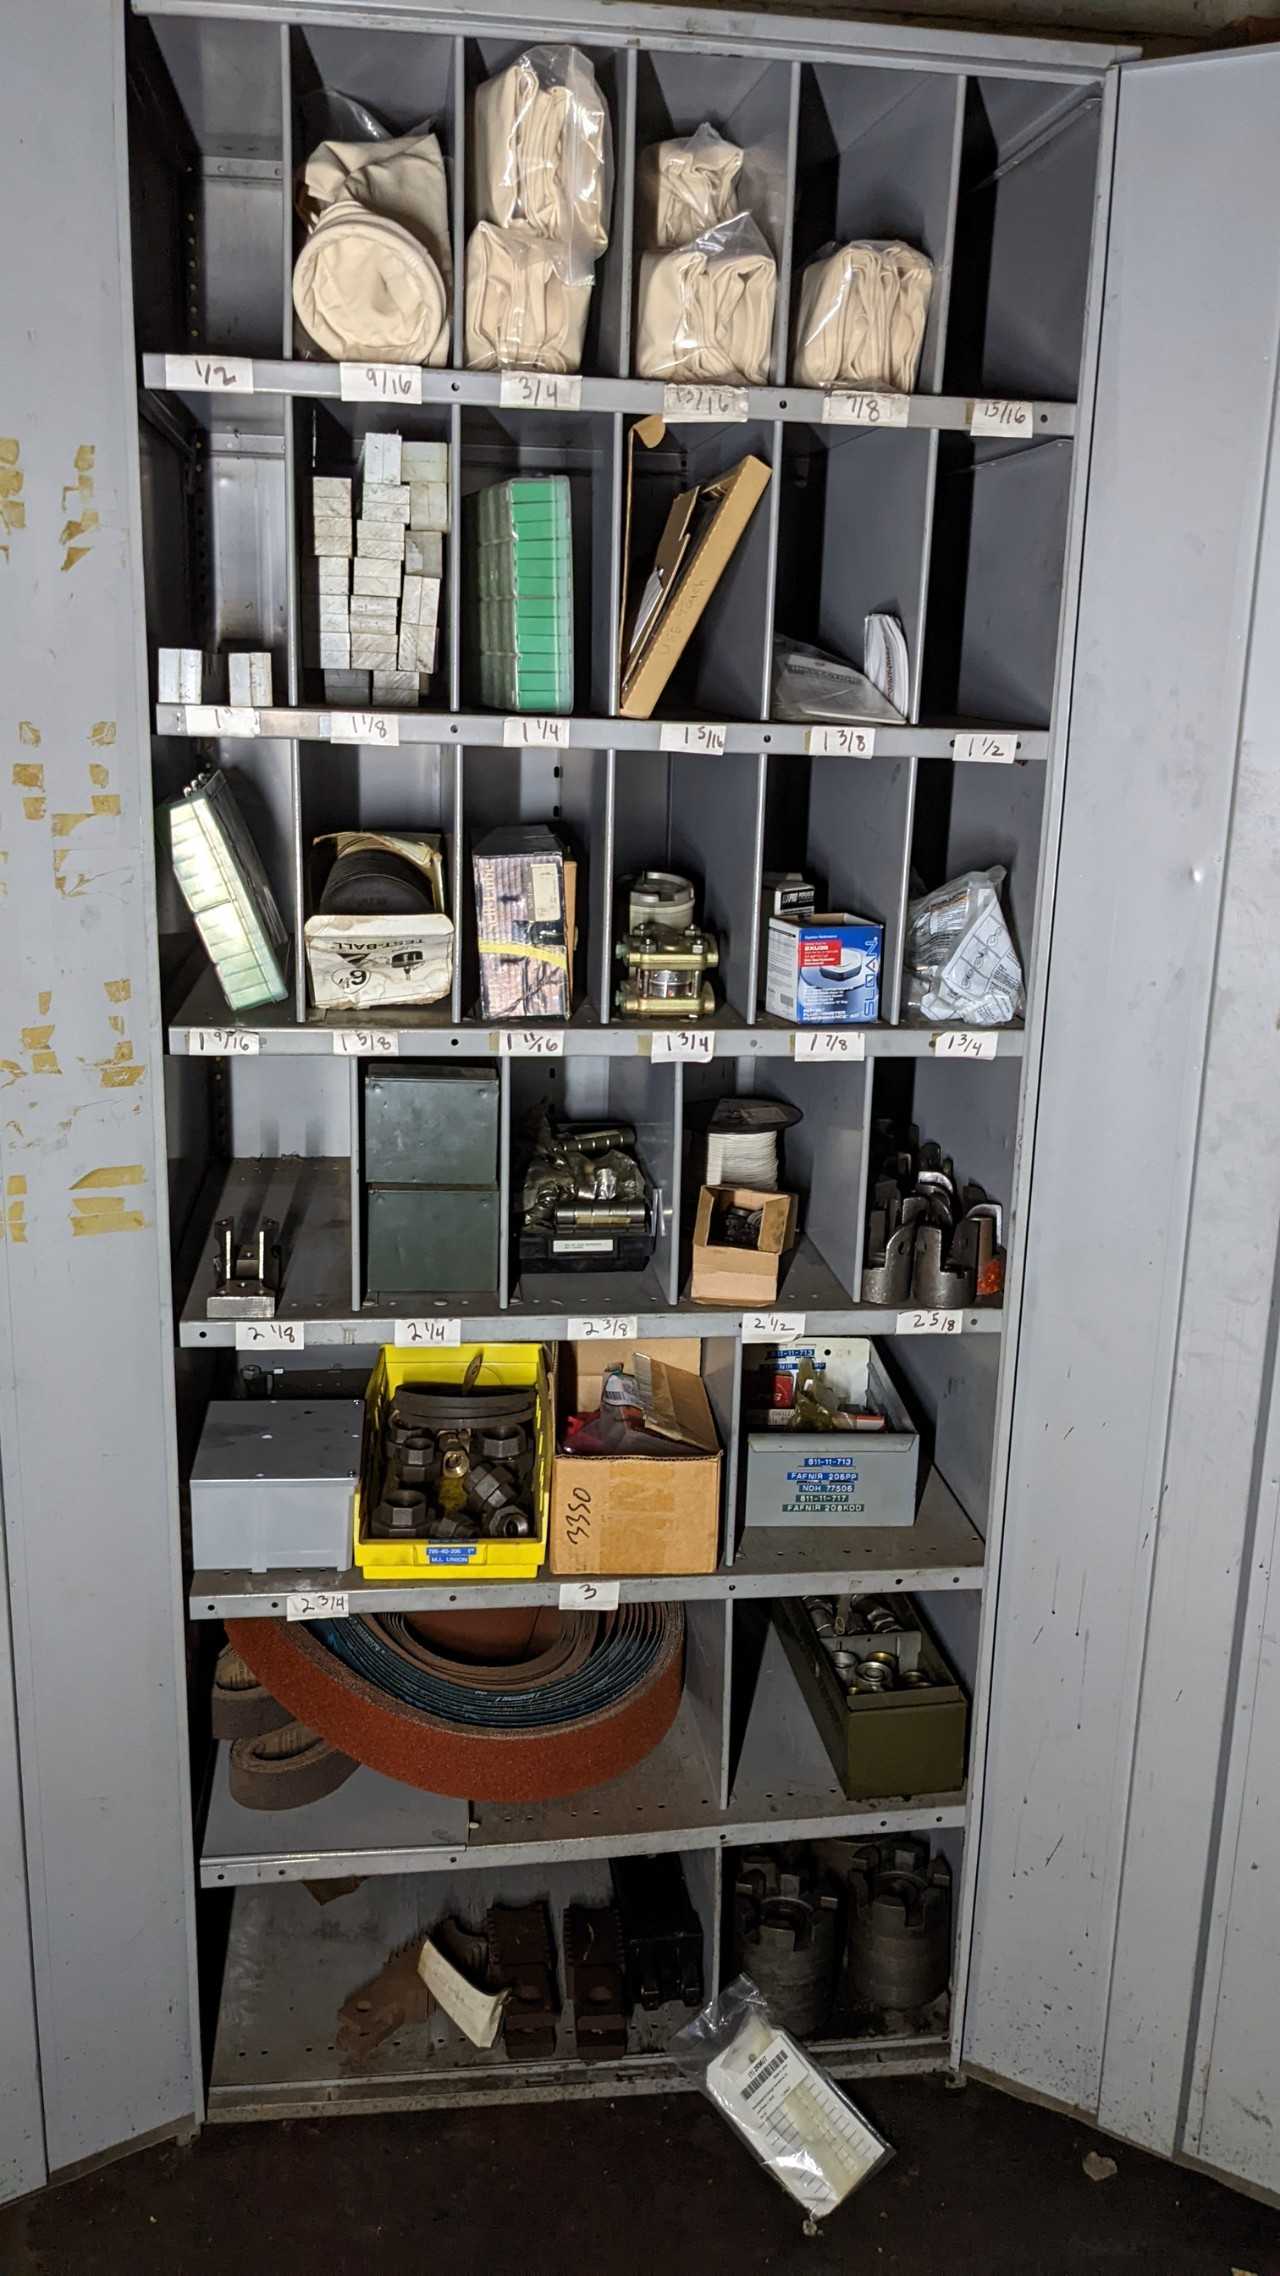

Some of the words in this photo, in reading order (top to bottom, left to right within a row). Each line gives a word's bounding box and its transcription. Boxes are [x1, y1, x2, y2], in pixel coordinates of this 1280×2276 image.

[196, 360, 237, 387] 1/2
[365, 368, 412, 396] 9/16
[518, 377, 559, 407] 3/4
[849, 397, 881, 422] 7/8
[982, 403, 1027, 426] 15/16
[863, 937, 879, 1017] SLOAN
[583, 1320, 600, 1337] 2
[753, 1318, 768, 1331] 2
[912, 1313, 927, 1329] 2
[247, 1326, 265, 1343] 2
[407, 1323, 423, 1340] 2
[791, 1472, 824, 1480] FAFNIR
[565, 1487, 592, 1545] 3350
[787, 1504, 821, 1512] FAFNIR
[578, 1583, 599, 1601] 3
[300, 1597, 316, 1615] 2
